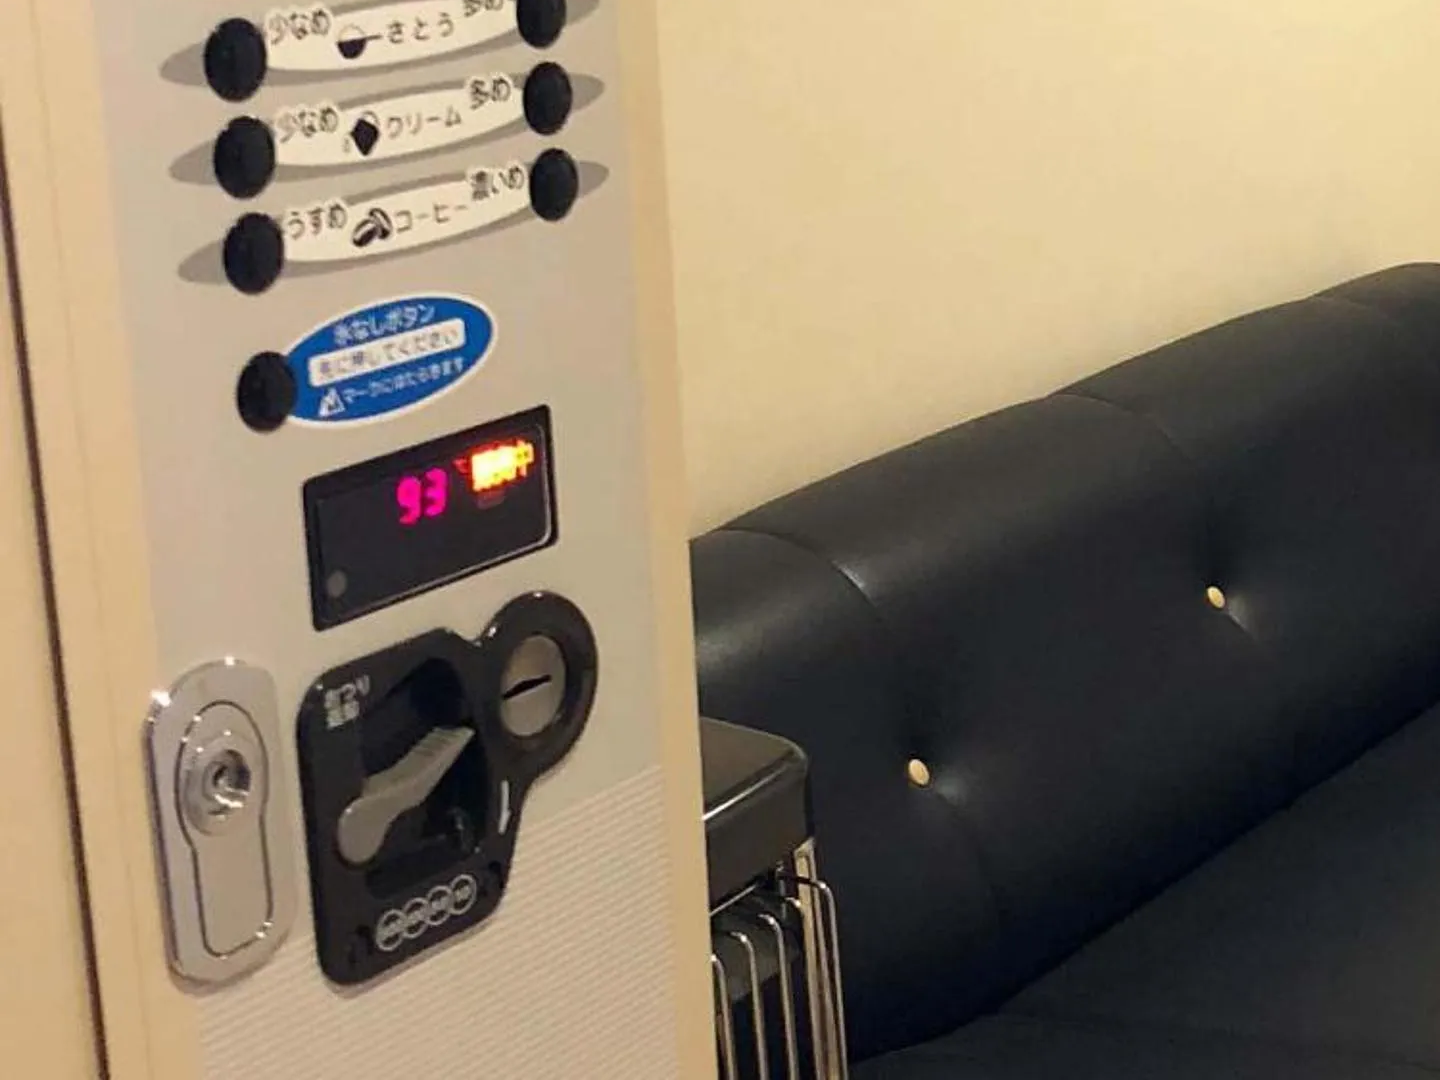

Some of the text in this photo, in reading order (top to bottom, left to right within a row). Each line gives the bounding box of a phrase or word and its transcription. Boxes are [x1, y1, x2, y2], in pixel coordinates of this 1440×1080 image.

[268, 9, 331, 45] 少なめ
[387, 12, 454, 44] さとう
[275, 78, 511, 143] 少なめ クリーム 多め
[287, 202, 348, 240] うすめ
[396, 200, 469, 233] コーヒー
[396, 468, 448, 525] 93
